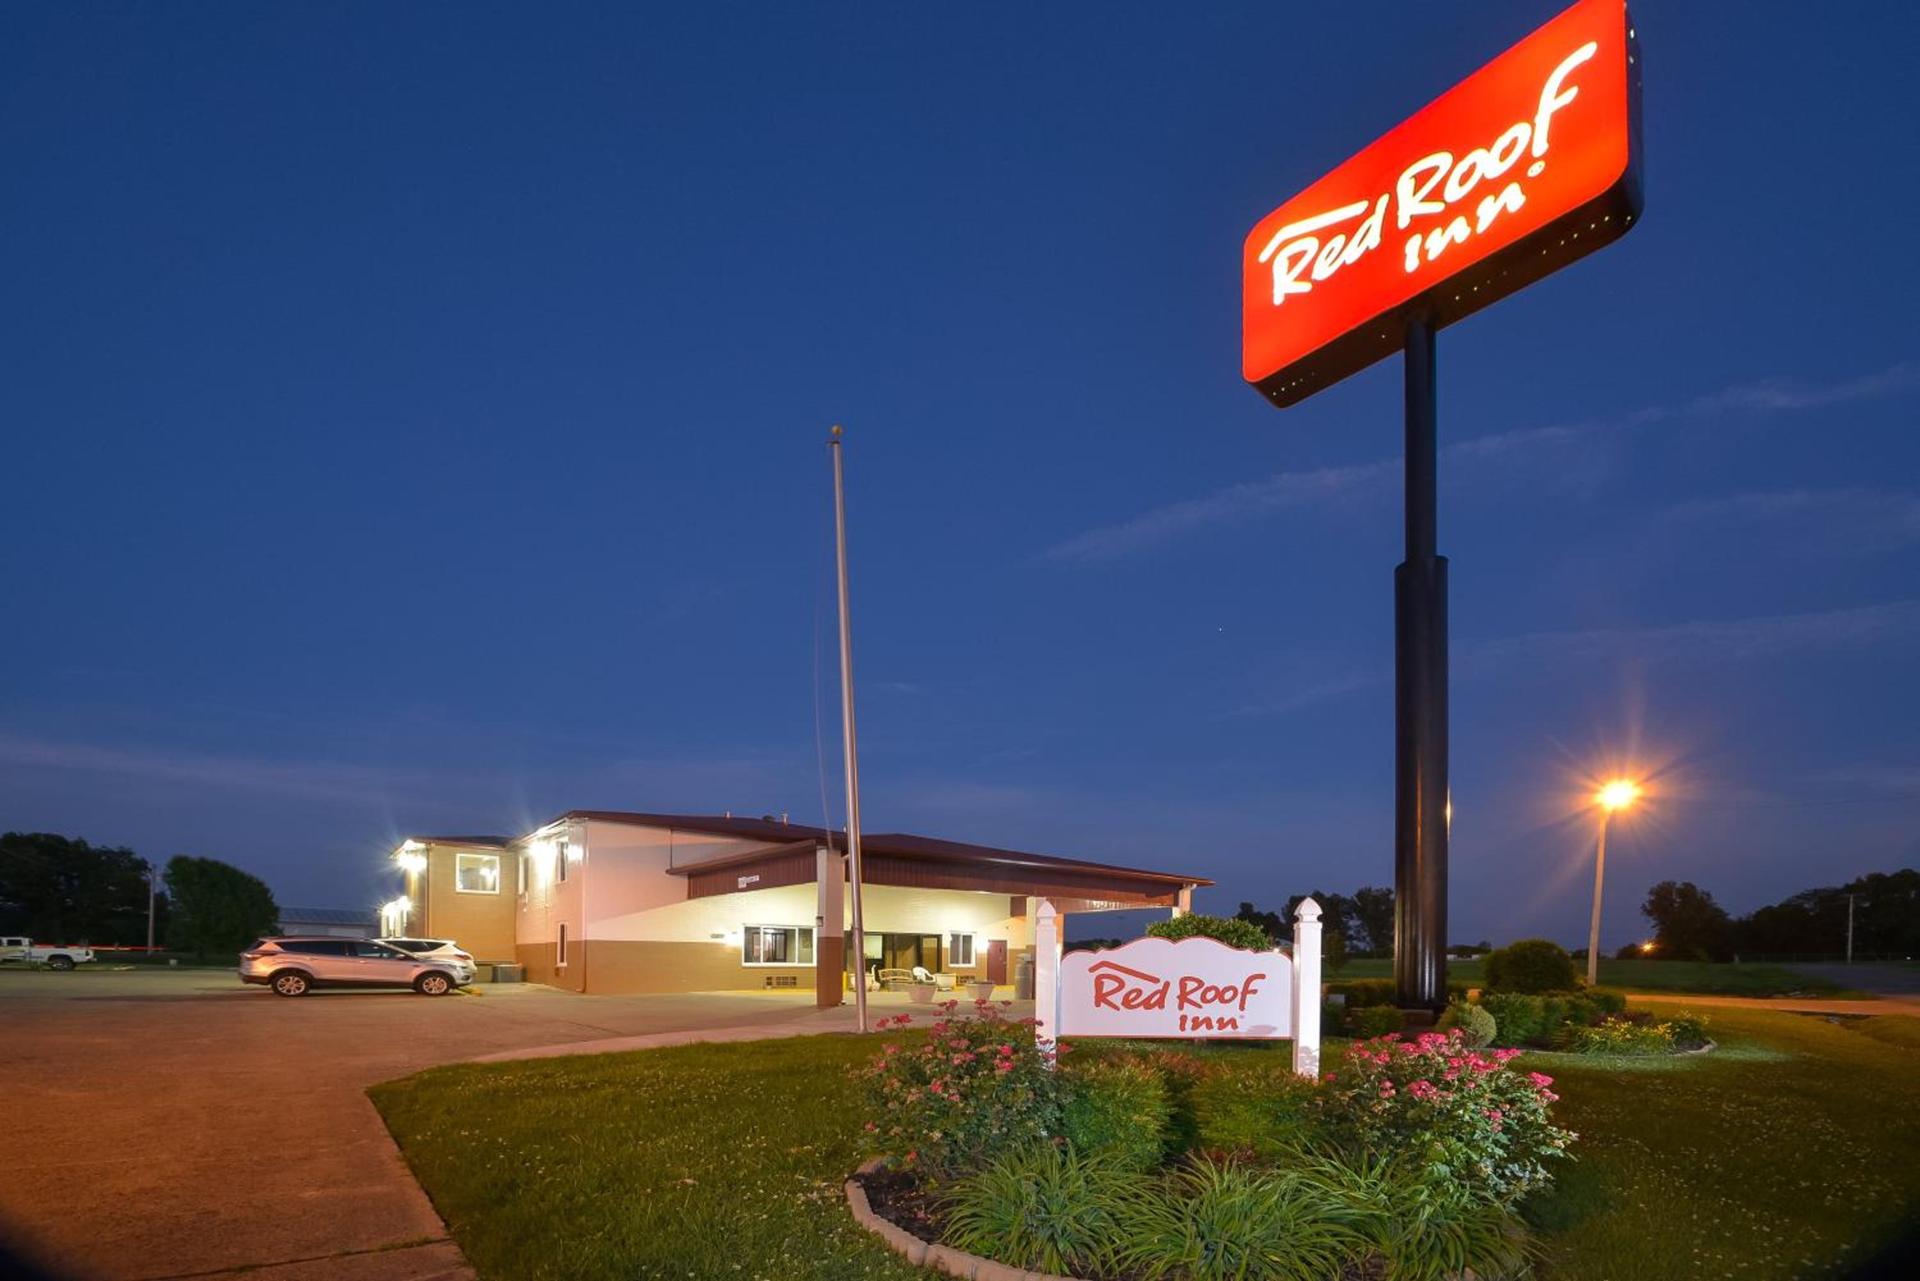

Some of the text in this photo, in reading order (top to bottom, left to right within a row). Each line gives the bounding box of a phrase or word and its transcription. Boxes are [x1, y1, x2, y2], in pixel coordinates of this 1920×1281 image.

[1272, 41, 1598, 306] Red Roof
[1094, 973, 1266, 1011] Red Roof
